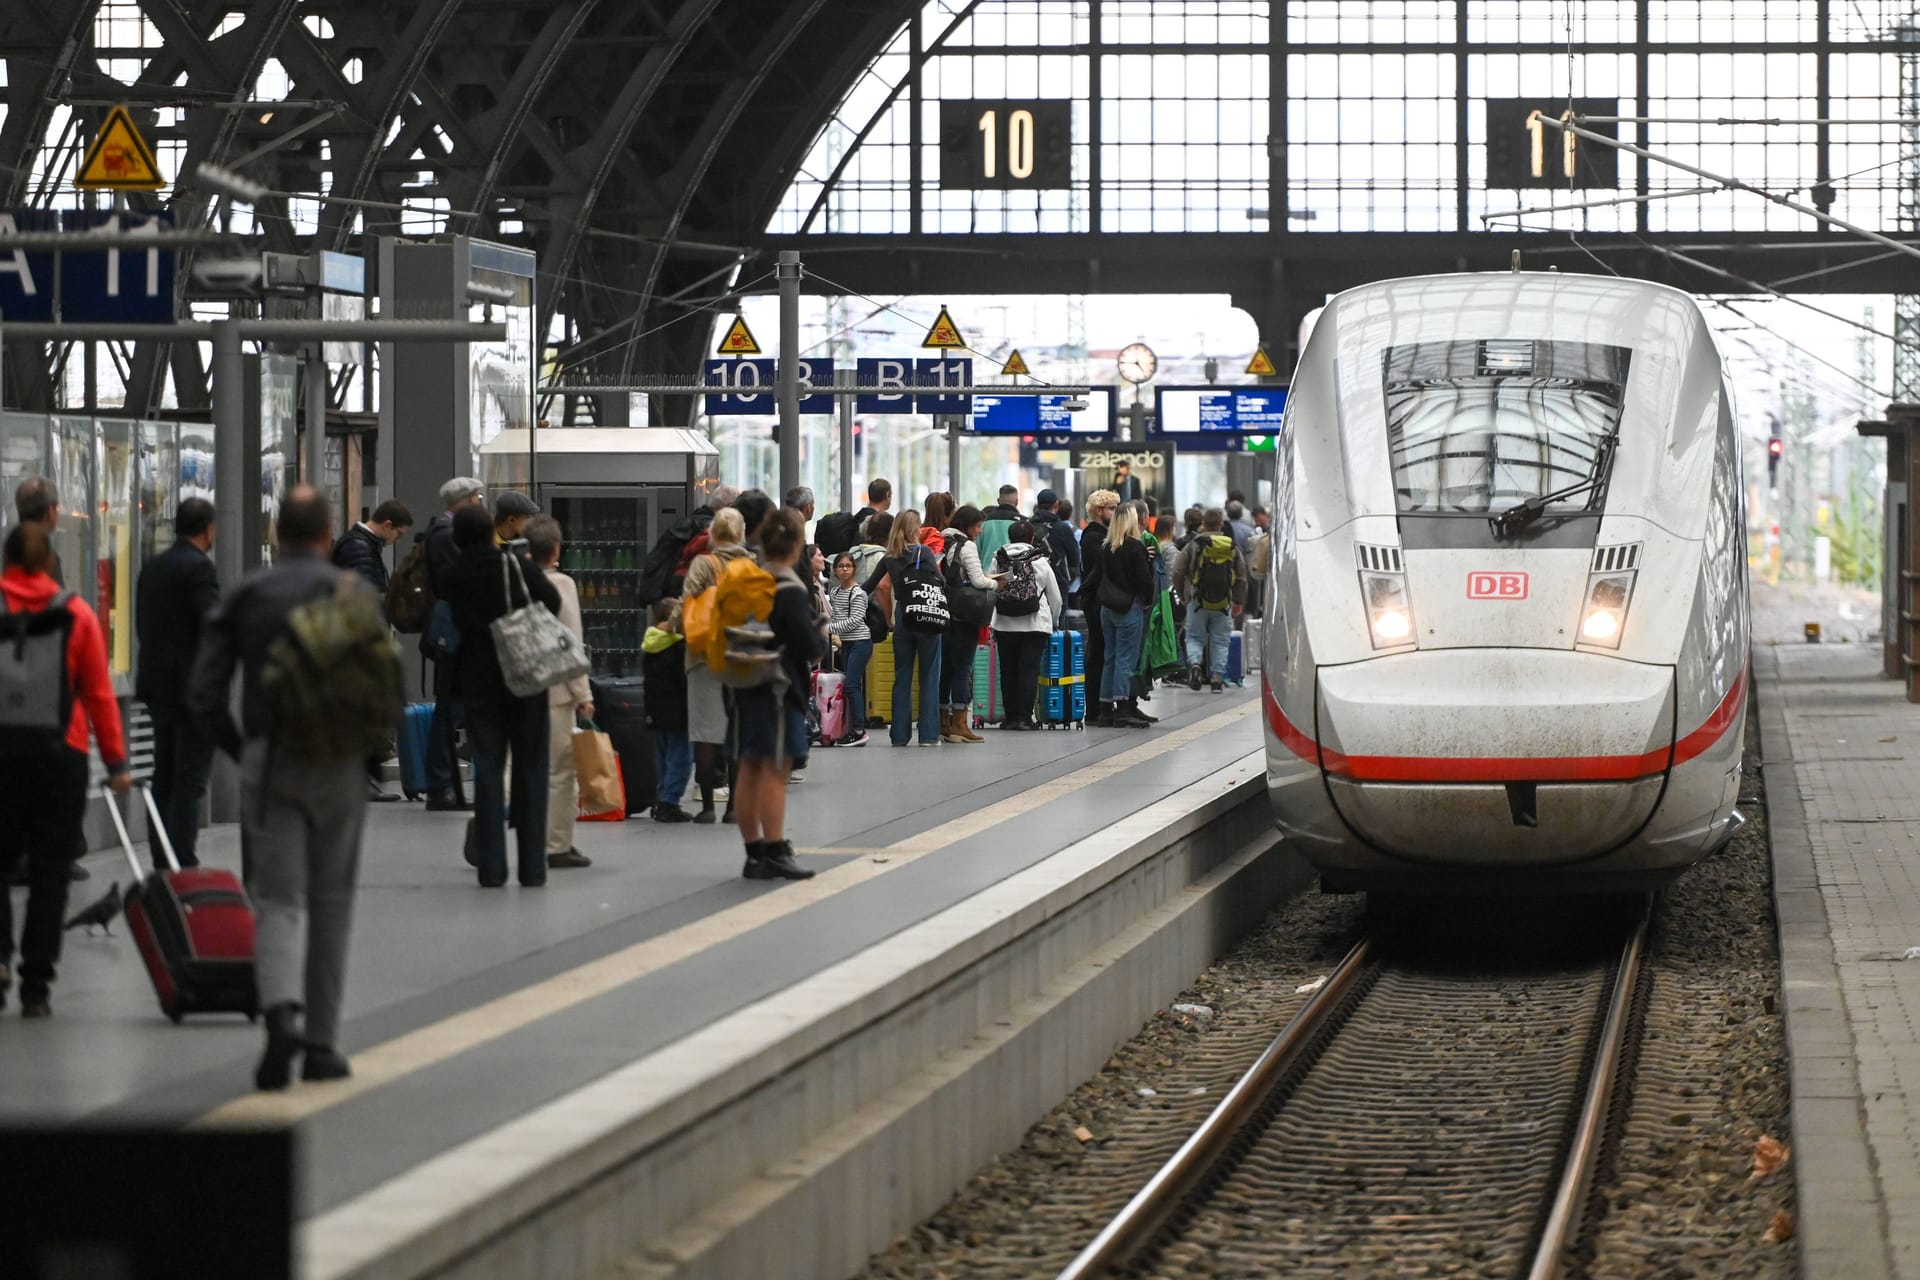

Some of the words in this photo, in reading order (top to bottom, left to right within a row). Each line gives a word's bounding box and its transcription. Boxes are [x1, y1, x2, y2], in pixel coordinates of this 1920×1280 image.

[977, 109, 1035, 179] 10
[1525, 109, 1576, 178] 11
[88, 214, 160, 296] 11
[711, 360, 761, 402] 10
[877, 361, 905, 401] B
[929, 361, 966, 401] 11
[1079, 450, 1165, 468] zalando
[920, 583, 943, 594] THE
[926, 598, 941, 607] OF
[1473, 574, 1522, 596] DB
